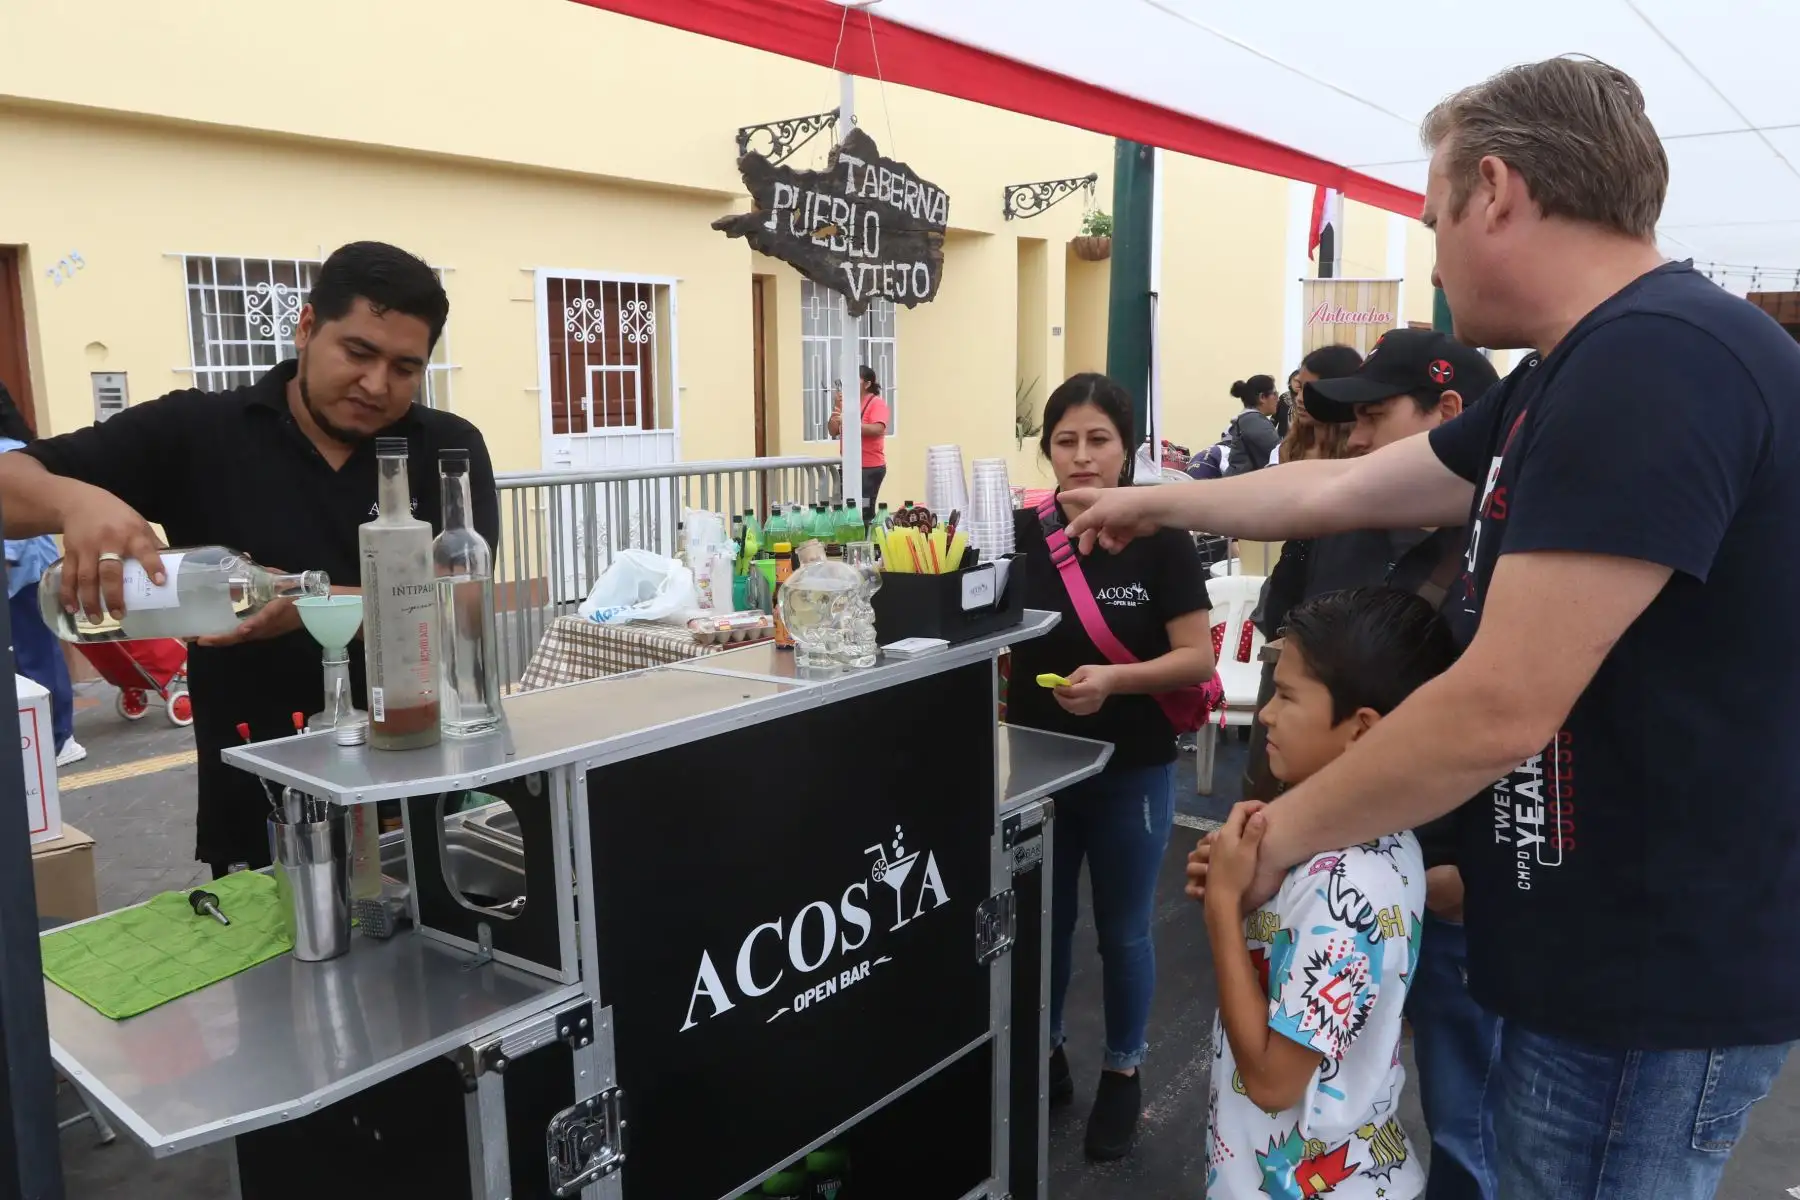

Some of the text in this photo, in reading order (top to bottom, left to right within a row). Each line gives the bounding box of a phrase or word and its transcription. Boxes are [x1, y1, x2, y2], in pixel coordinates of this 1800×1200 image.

[838, 152, 949, 226] TABERNA
[763, 182, 880, 259] PUEBLO
[839, 261, 931, 301] VIEJO
[1306, 302, 1393, 327] Anticuchos
[1095, 581, 1151, 601] ACOSTA
[1517, 851, 1531, 890] CMPD
[679, 835, 951, 1033] ACOSTA
[793, 960, 871, 1013] OPEN BAR
